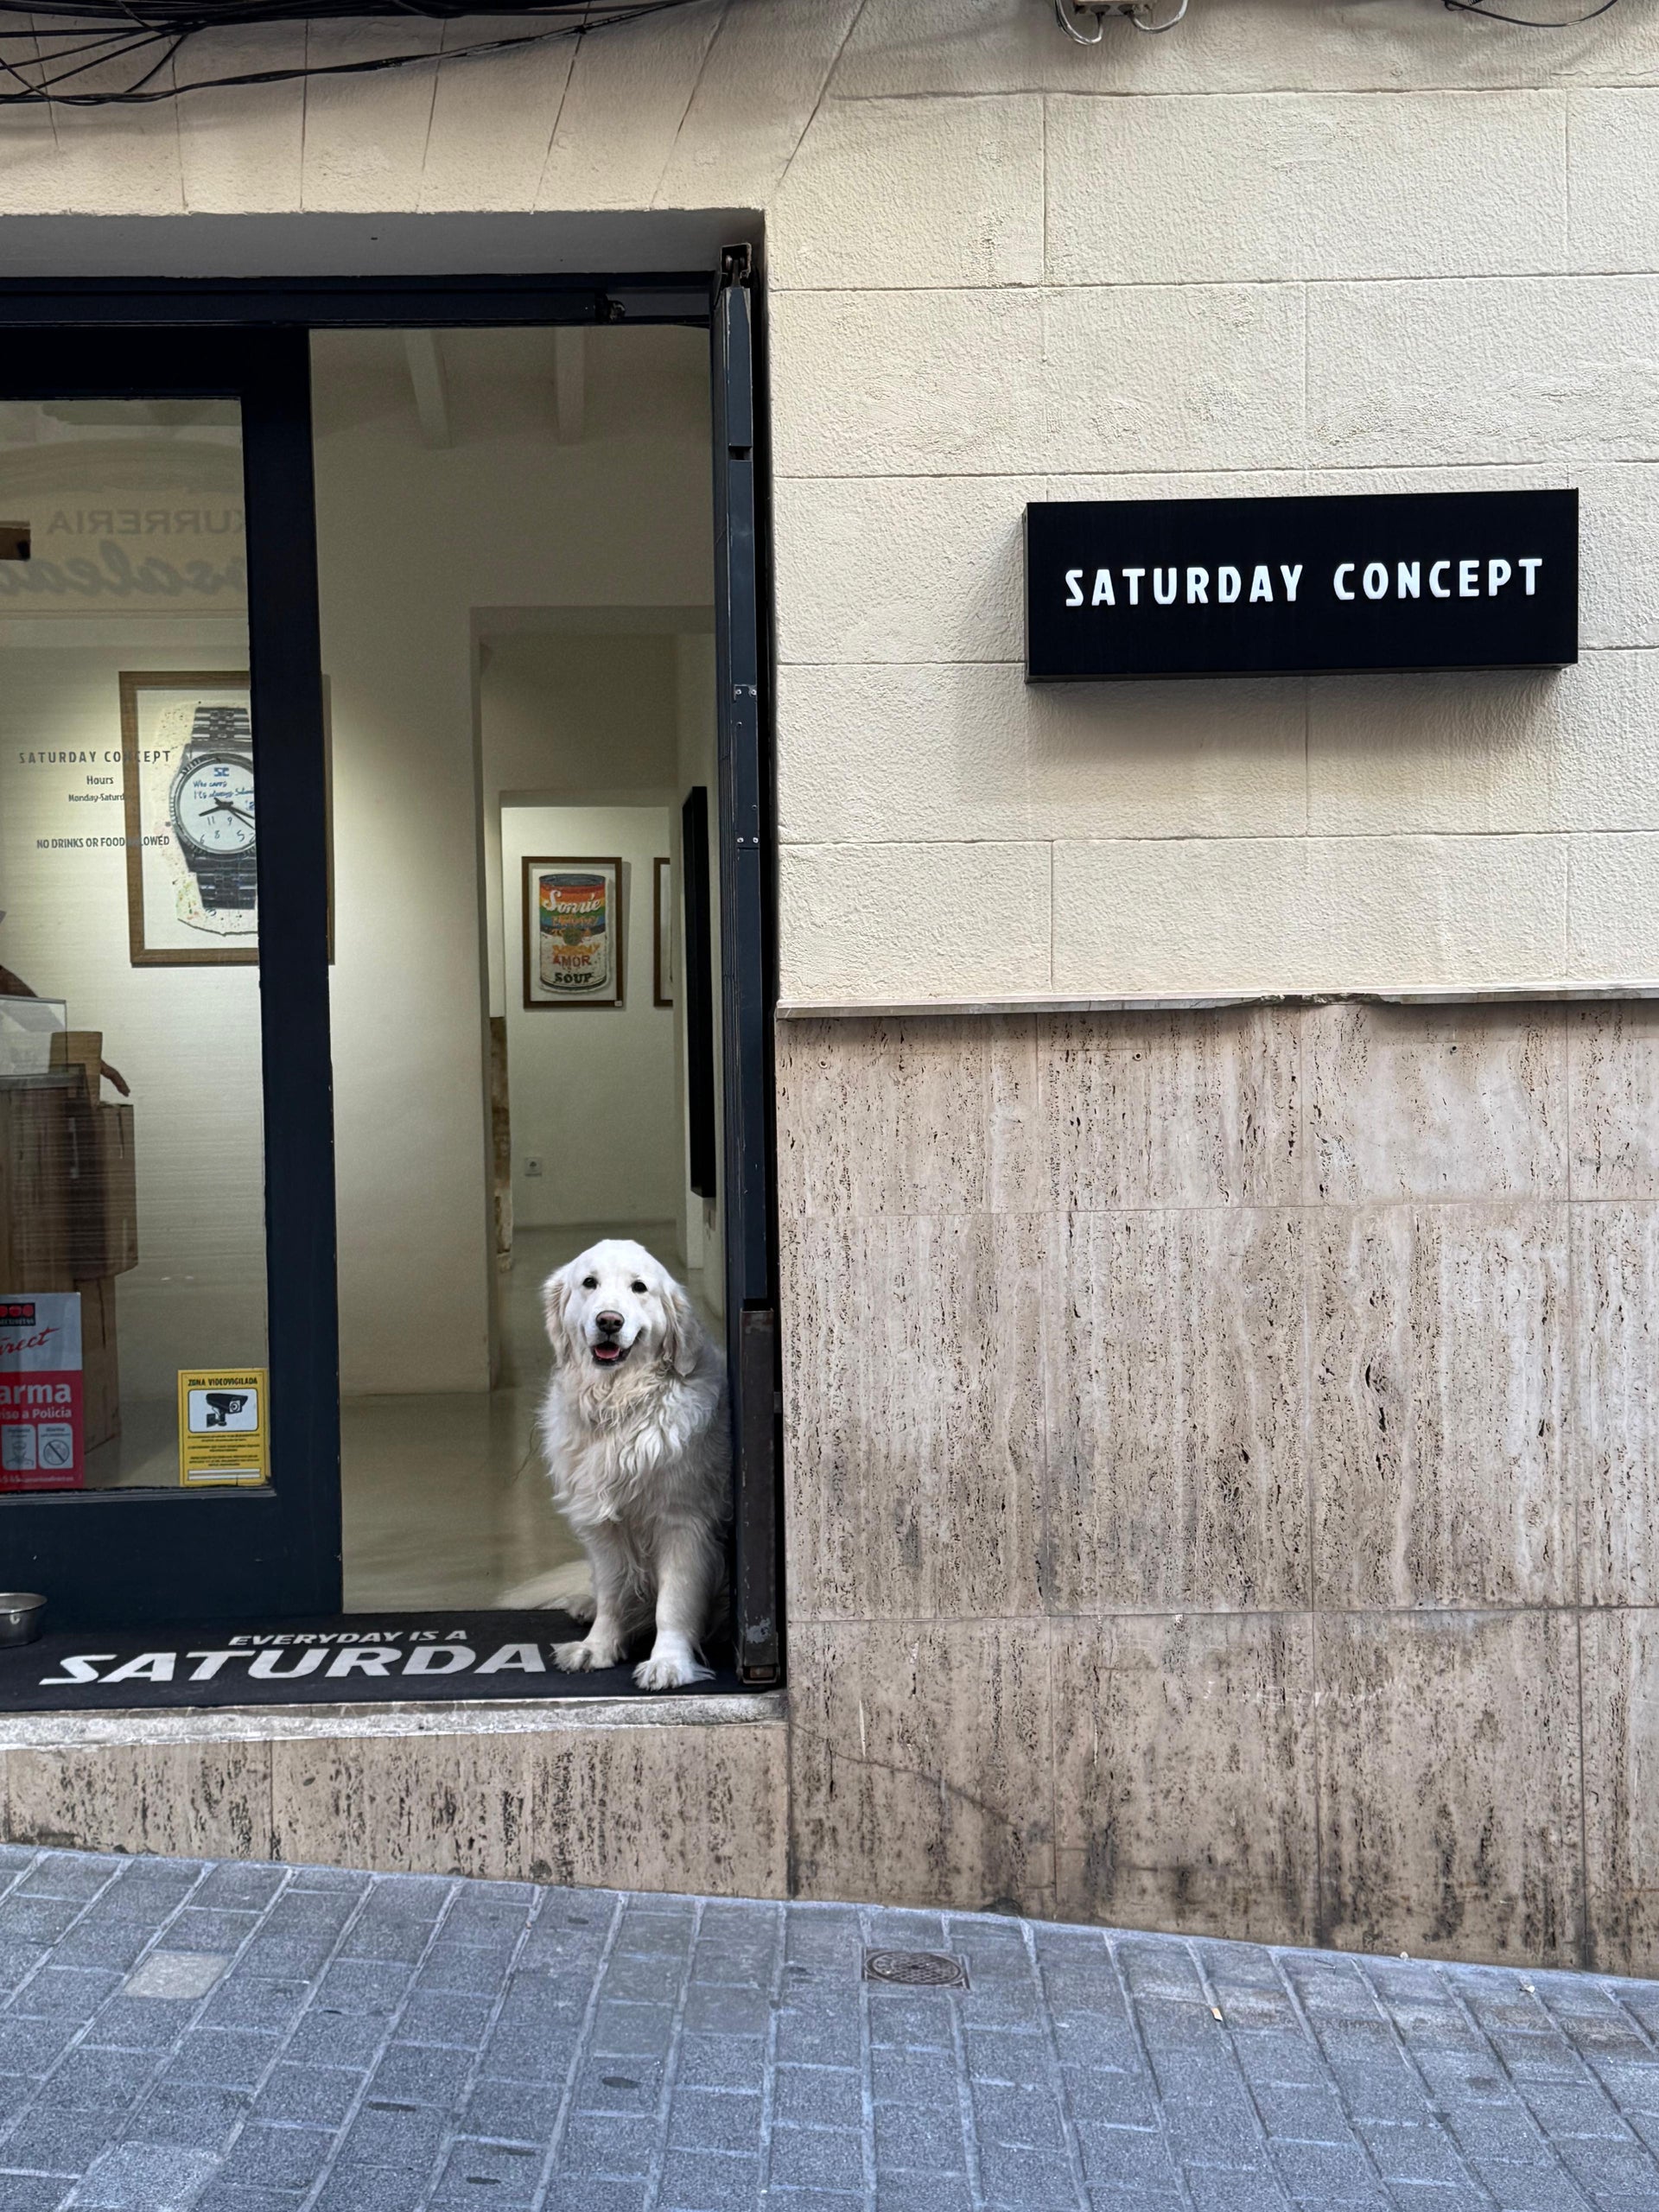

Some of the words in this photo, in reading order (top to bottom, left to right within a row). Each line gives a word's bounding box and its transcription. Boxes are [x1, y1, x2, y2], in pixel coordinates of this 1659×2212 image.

[1065, 564, 1303, 607] SATURDAY
[1333, 558, 1543, 601] CONCEPT
[19, 751, 97, 764] SATURDAY
[105, 750, 171, 763] COEPT
[86, 775, 114, 785] Hours
[37, 839, 49, 849] NO
[52, 837, 84, 849] DRINKS
[86, 837, 99, 848] OR
[100, 836, 125, 847] FOOD
[554, 972, 594, 983] SOUP
[208, 1376, 257, 1386] VIDEOVIGILADA
[228, 1631, 404, 1646] EVERYDAY
[409, 1630, 438, 1641] IS
[445, 1630, 467, 1641] A
[39, 1643, 558, 1686] SATURDA
